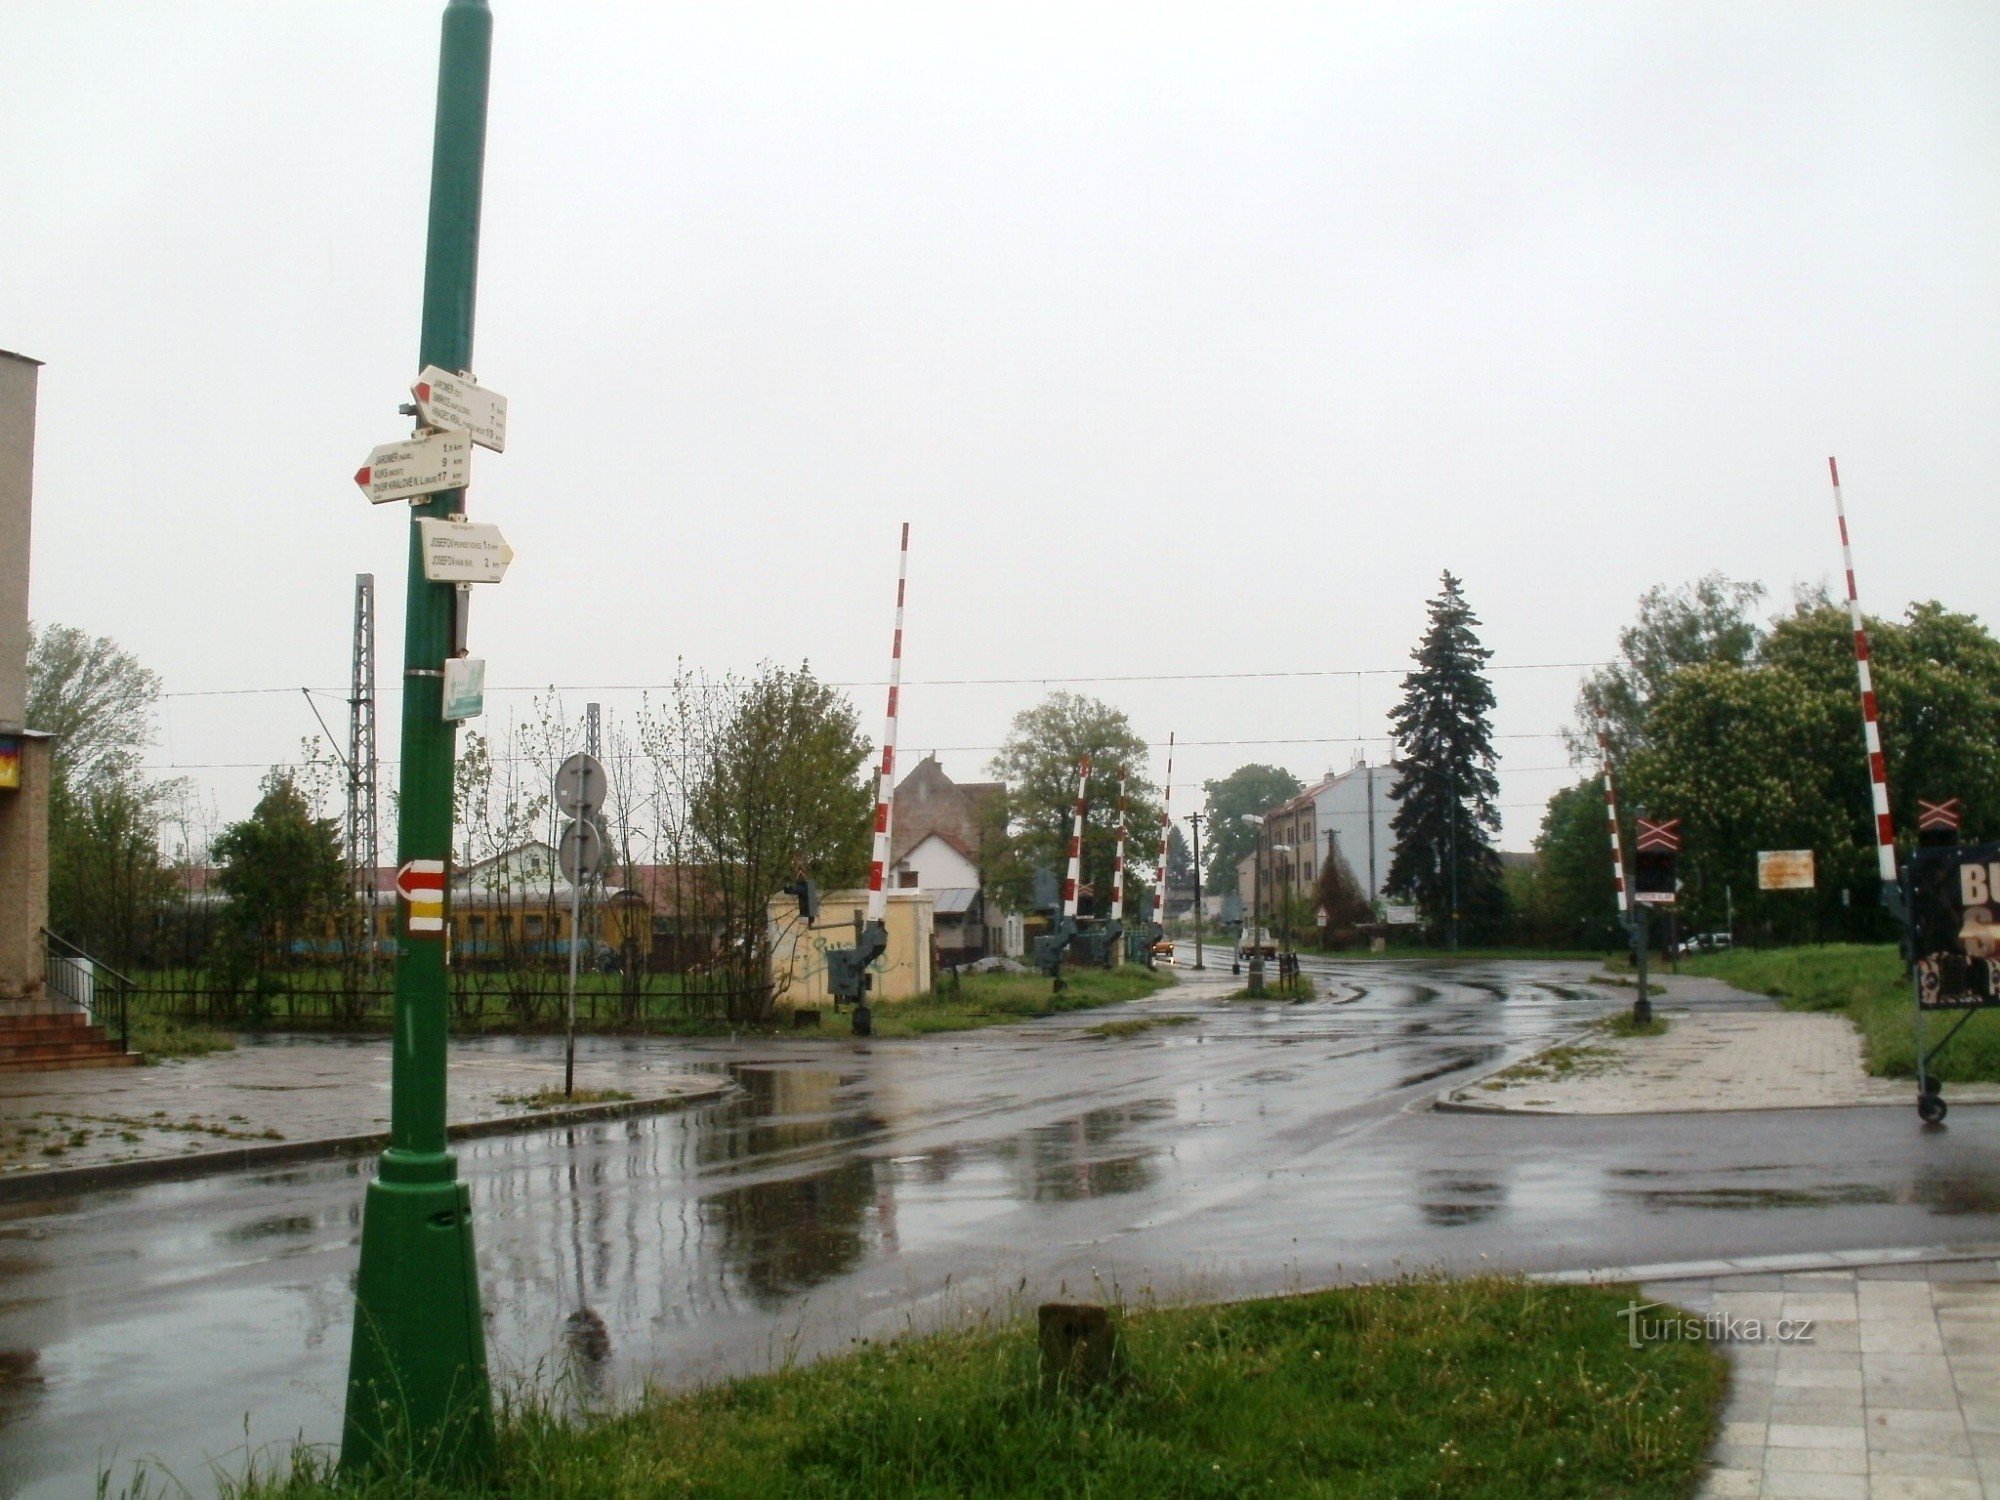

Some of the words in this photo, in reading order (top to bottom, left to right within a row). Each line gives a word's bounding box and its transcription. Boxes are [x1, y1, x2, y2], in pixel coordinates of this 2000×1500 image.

[453, 441, 463, 451] km
[441, 456, 447, 467] 9
[453, 456, 462, 465] km
[437, 470, 447, 481] 17
[484, 557, 488, 567] 2
